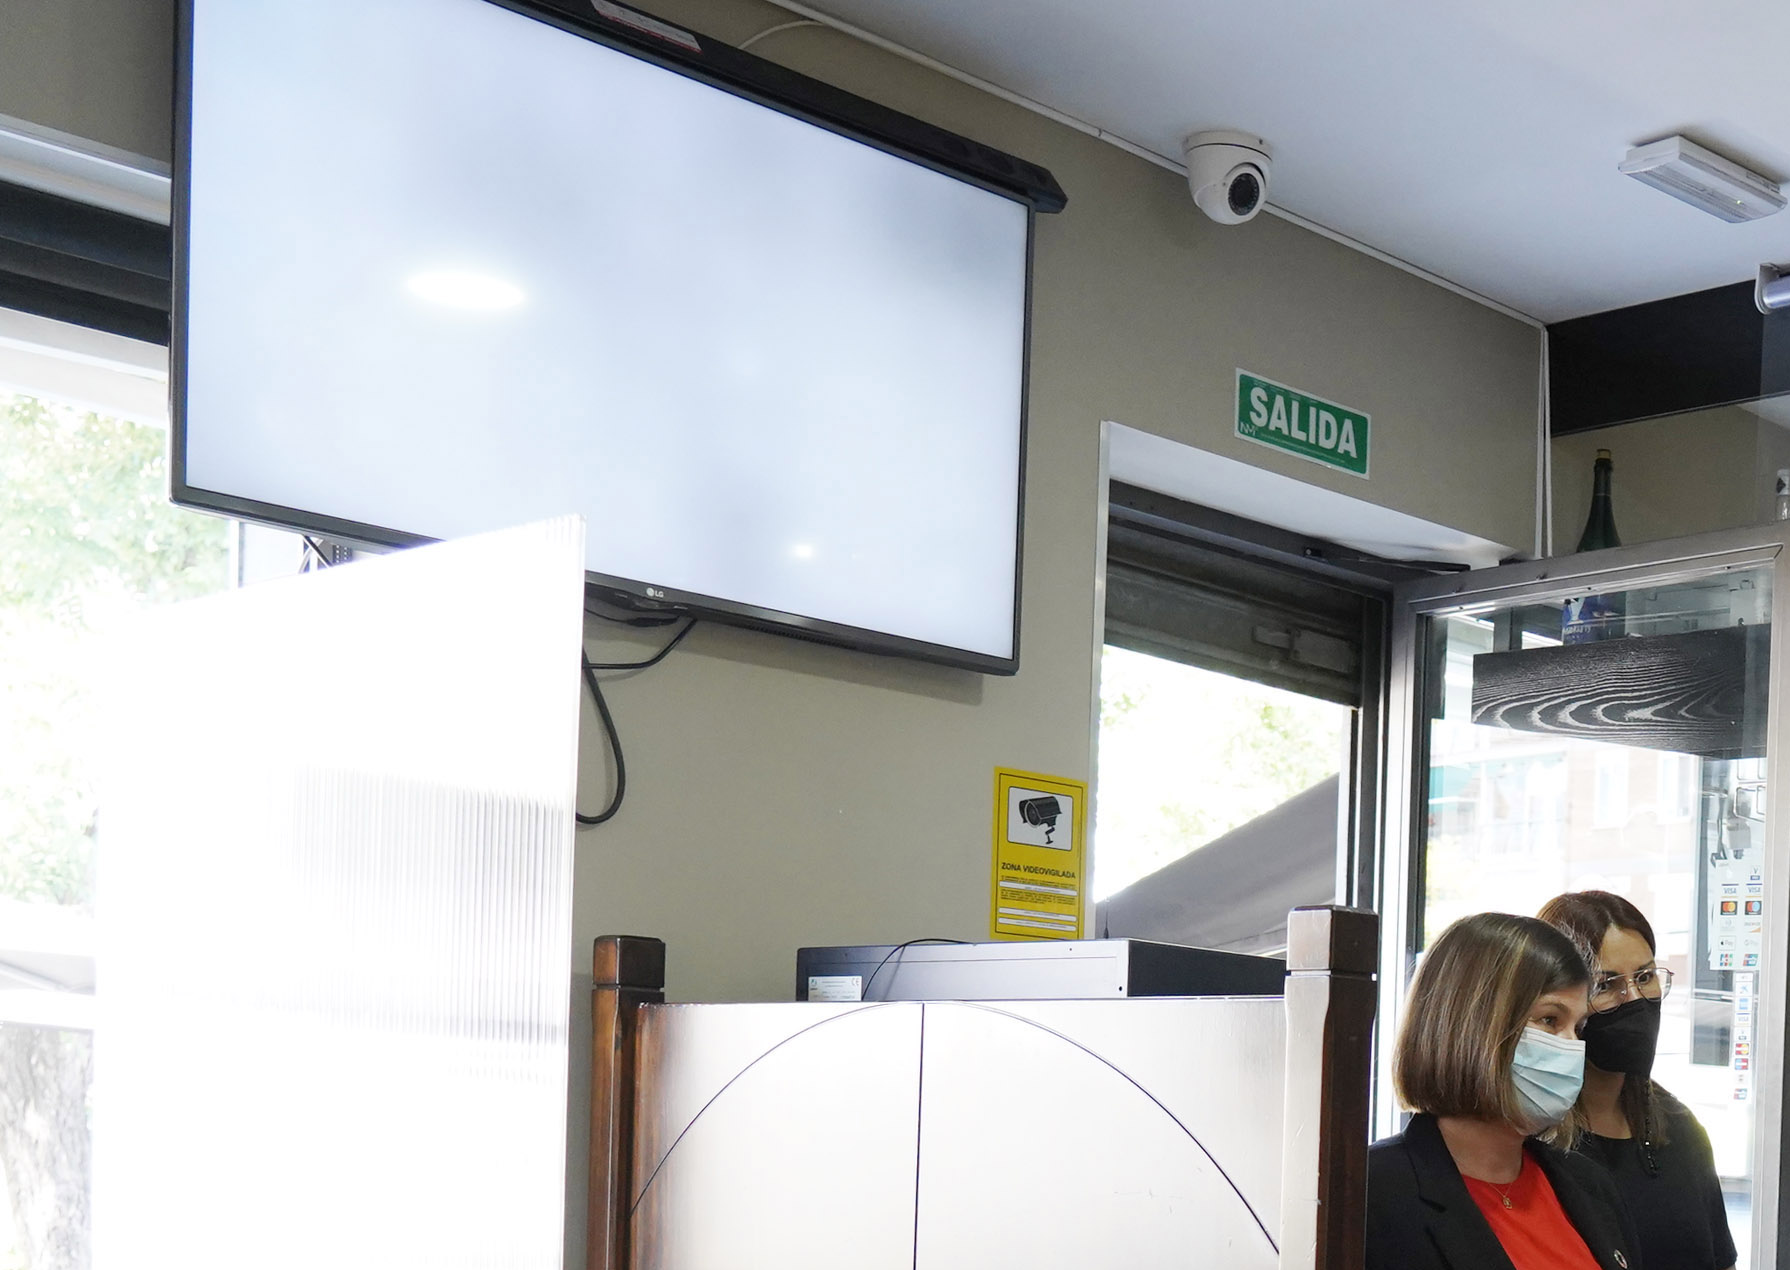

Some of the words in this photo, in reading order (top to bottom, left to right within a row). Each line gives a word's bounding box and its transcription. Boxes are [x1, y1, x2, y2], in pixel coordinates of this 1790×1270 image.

[1249, 387, 1358, 458] SALIDA
[1001, 862, 1021, 871] ZONA
[1023, 865, 1076, 879] VIDEOVIGILADA
[1747, 886, 1761, 894] VISA
